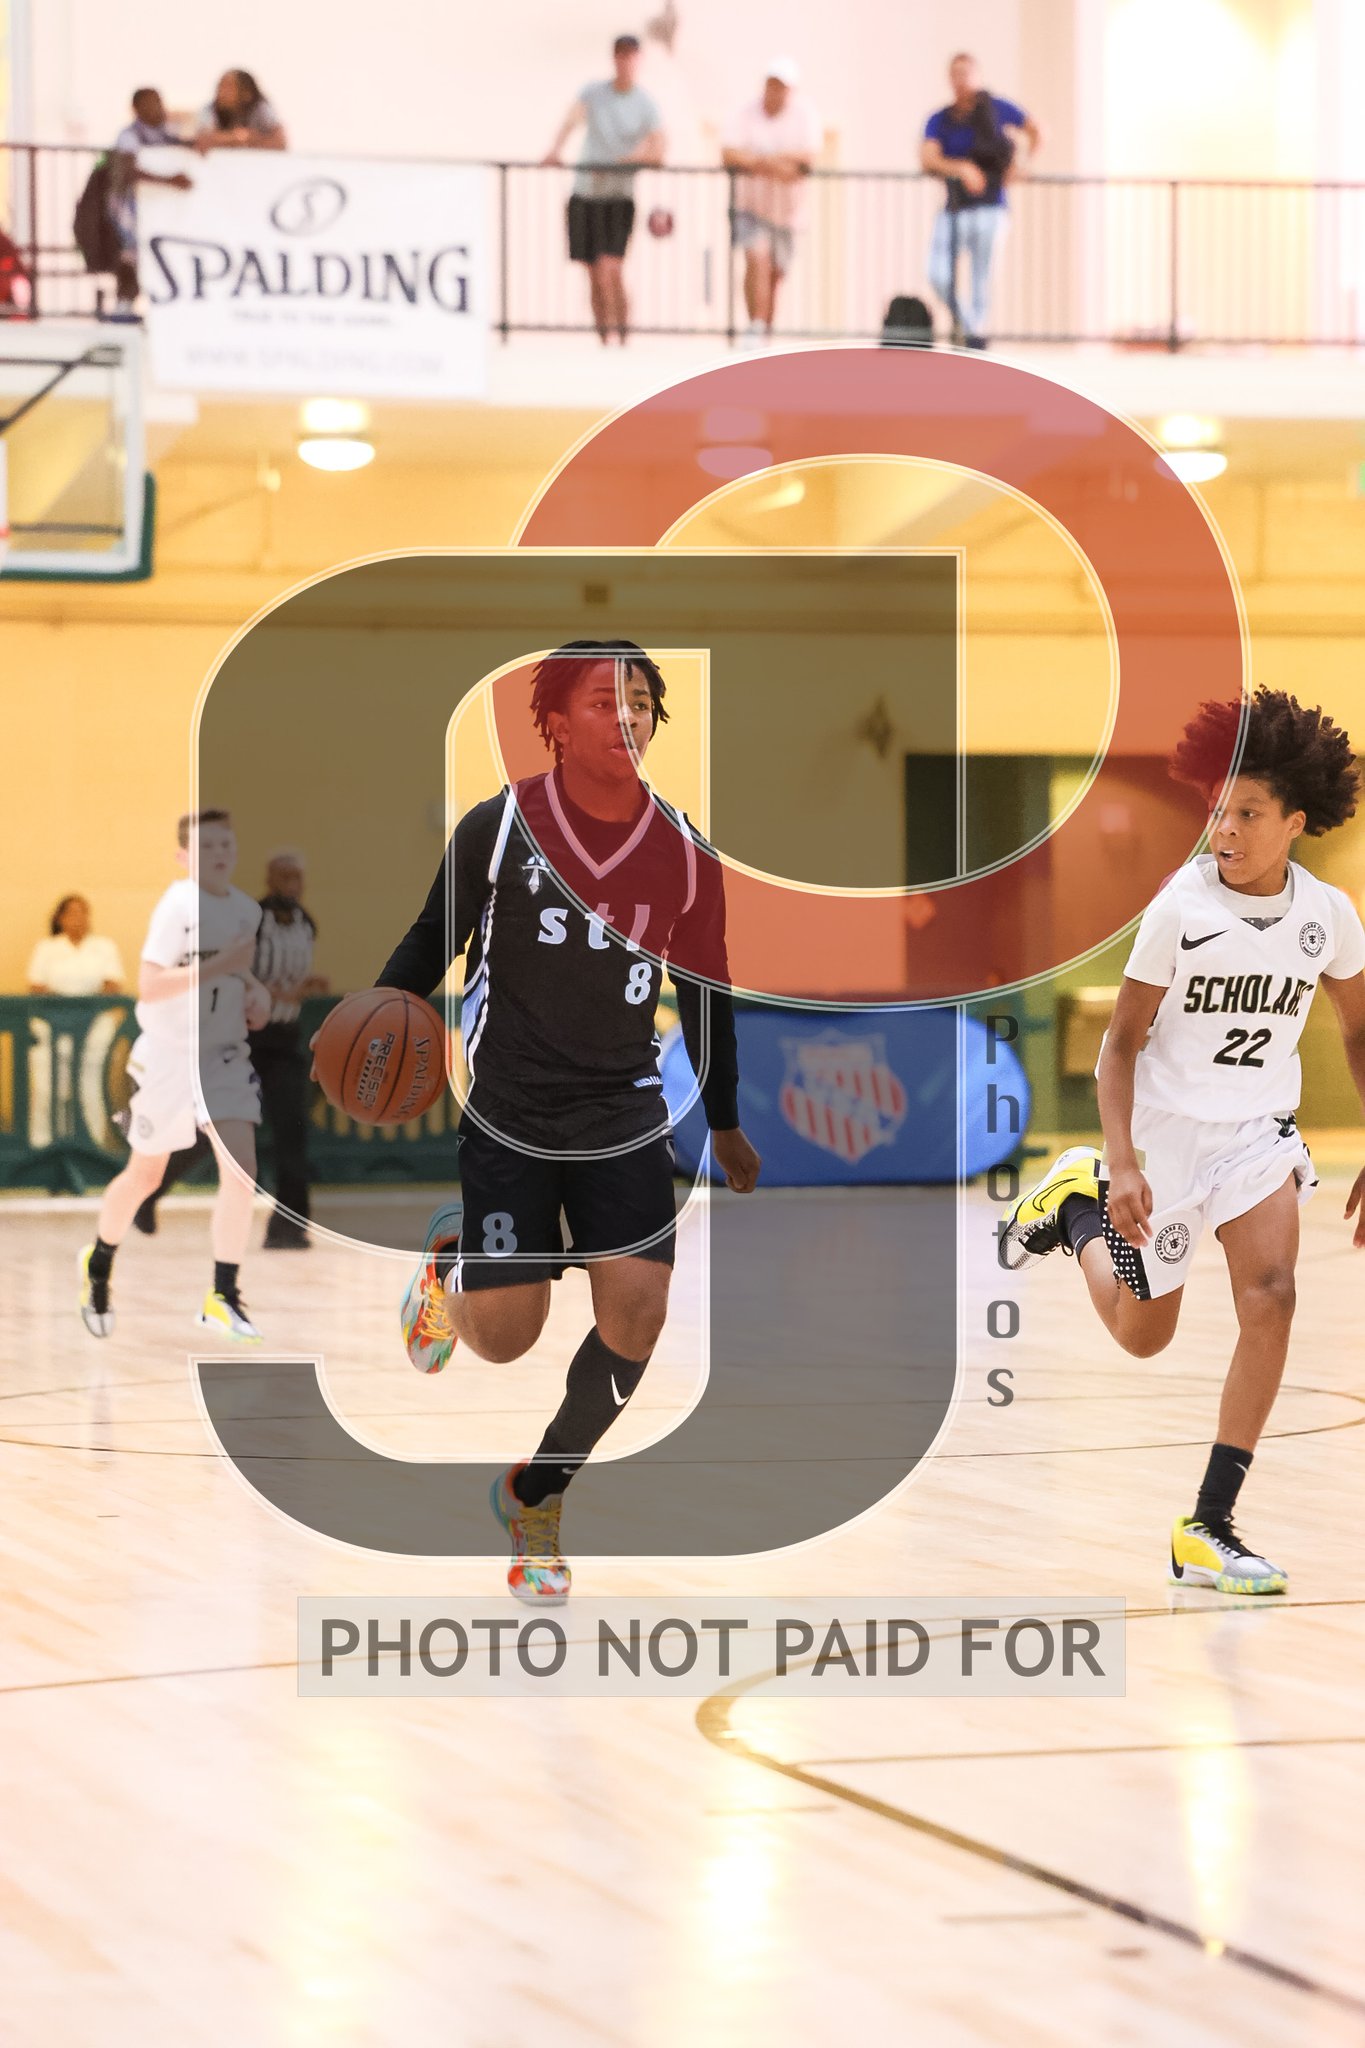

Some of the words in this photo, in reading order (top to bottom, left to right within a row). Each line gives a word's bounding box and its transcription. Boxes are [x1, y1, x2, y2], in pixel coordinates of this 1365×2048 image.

[150, 235, 467, 314] SPALDING
[538, 903, 651, 951] stl
[625, 962, 652, 1005] 8
[1213, 1028, 1272, 1068] 22
[482, 1212, 518, 1257] 8
